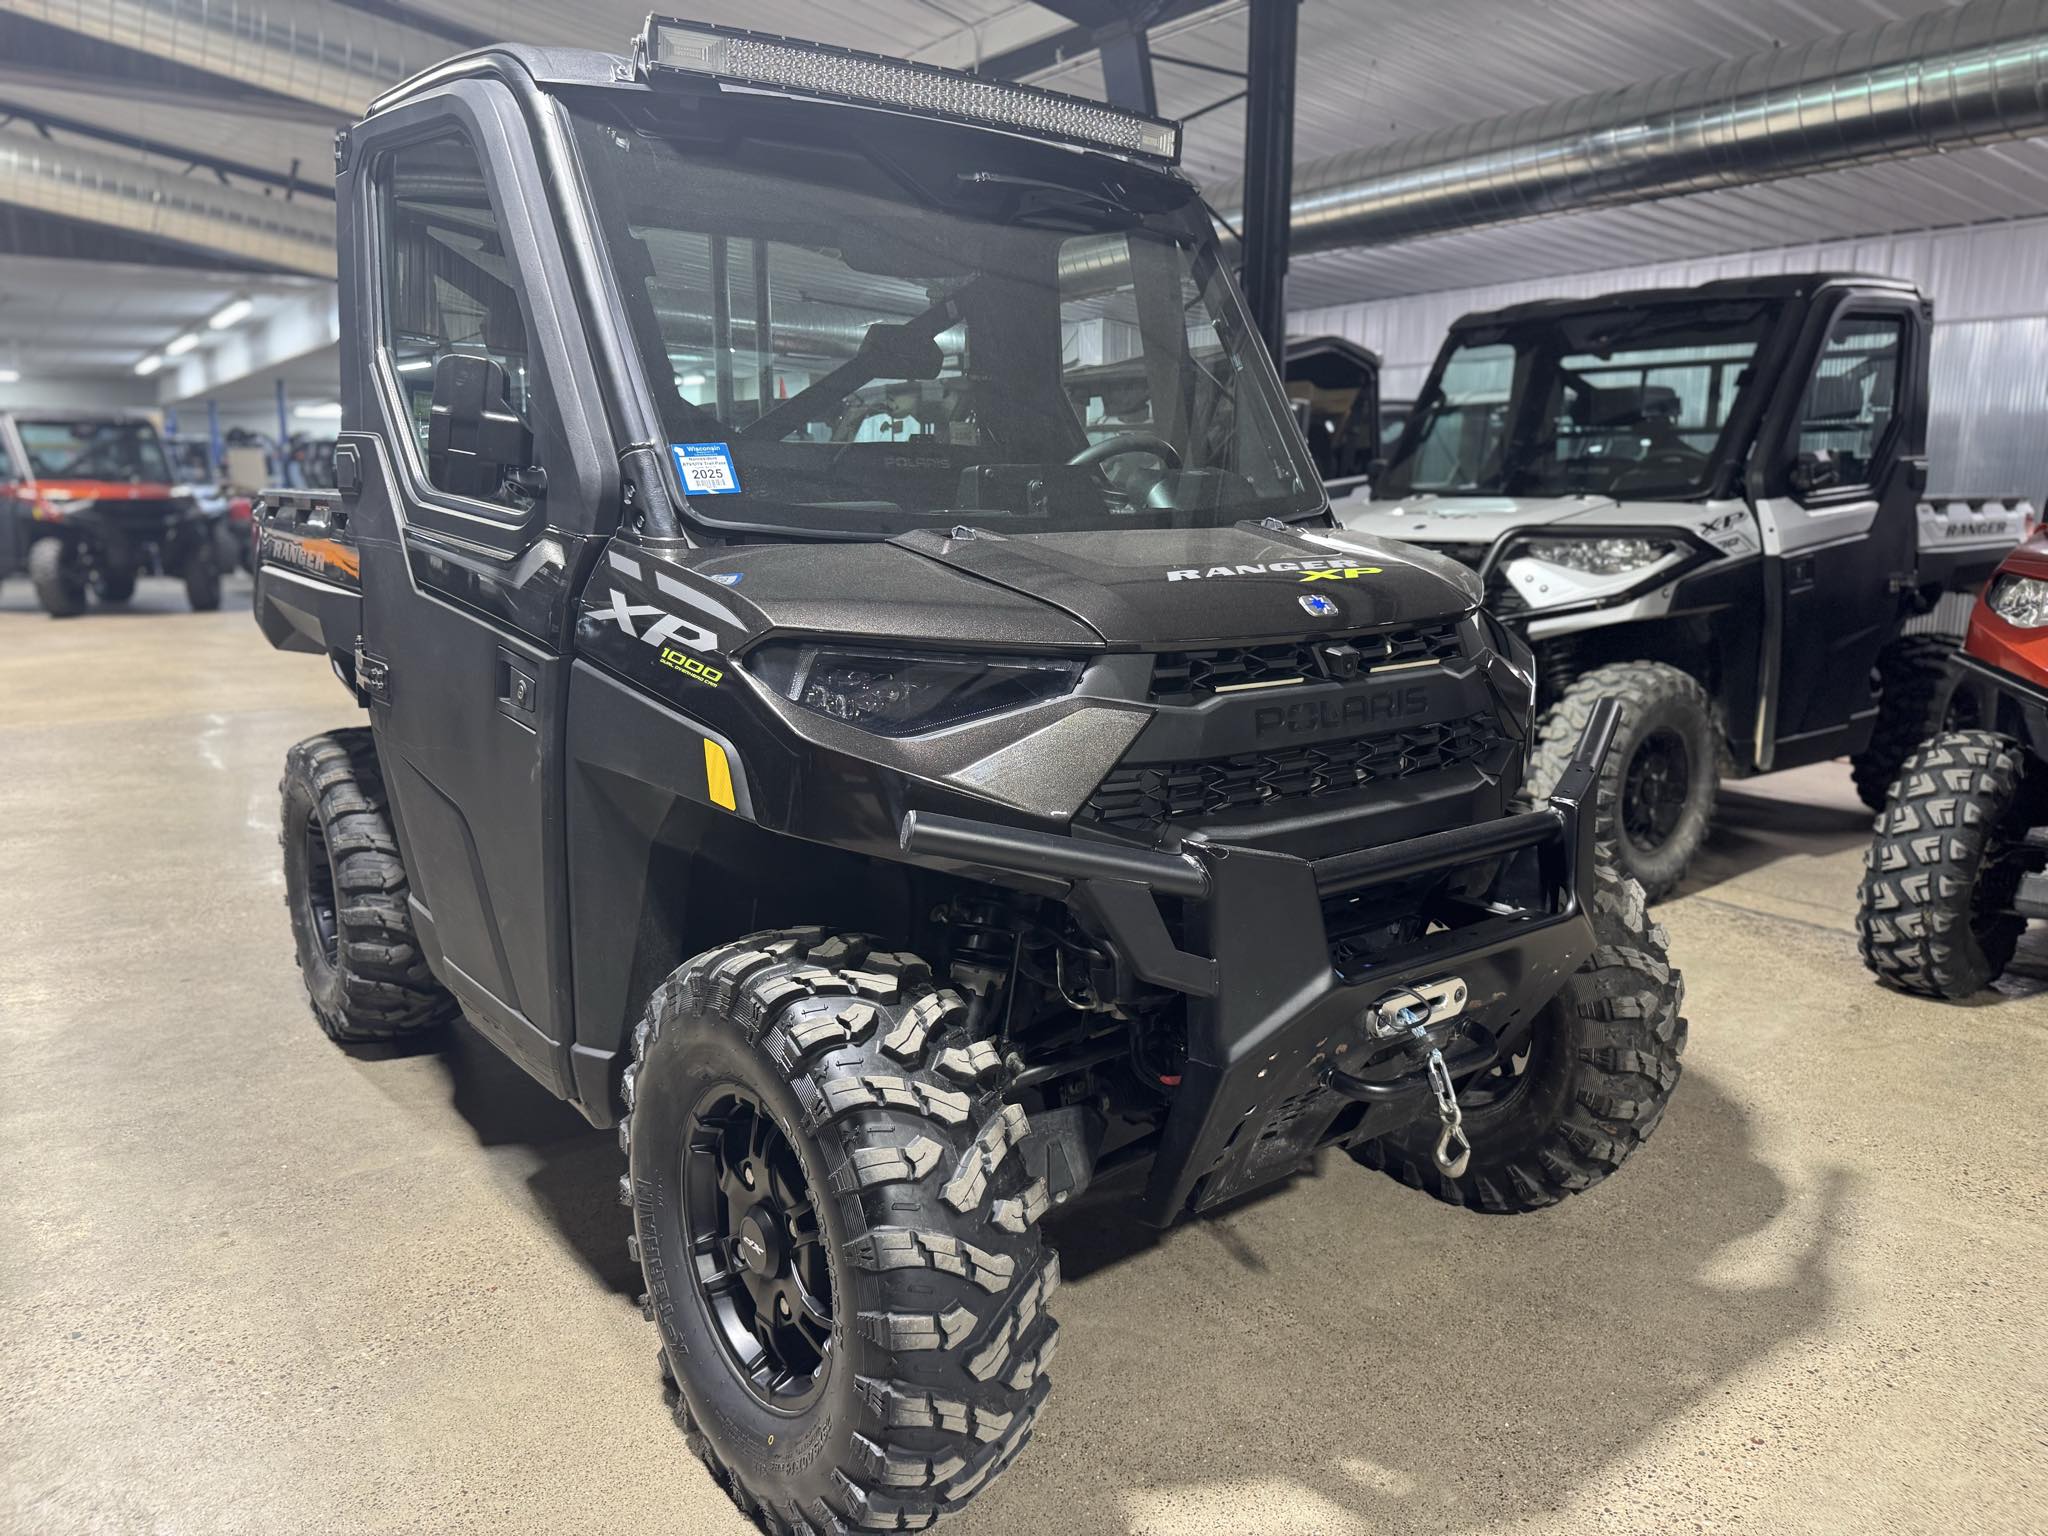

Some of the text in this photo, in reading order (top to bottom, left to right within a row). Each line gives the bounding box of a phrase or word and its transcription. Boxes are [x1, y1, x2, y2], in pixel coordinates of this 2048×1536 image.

[692, 468, 723, 480] 2025
[884, 456, 951, 469] POLARIS
[1700, 511, 1749, 537] XP
[1945, 521, 2008, 538] RANGER
[272, 539, 326, 572] RANGER
[1166, 559, 1360, 582] RANGER
[1296, 567, 1384, 583] XP
[584, 588, 718, 652] XP
[660, 647, 725, 682] 1000
[1254, 686, 1429, 739] POLARIS
[743, 1236, 765, 1256] XP
